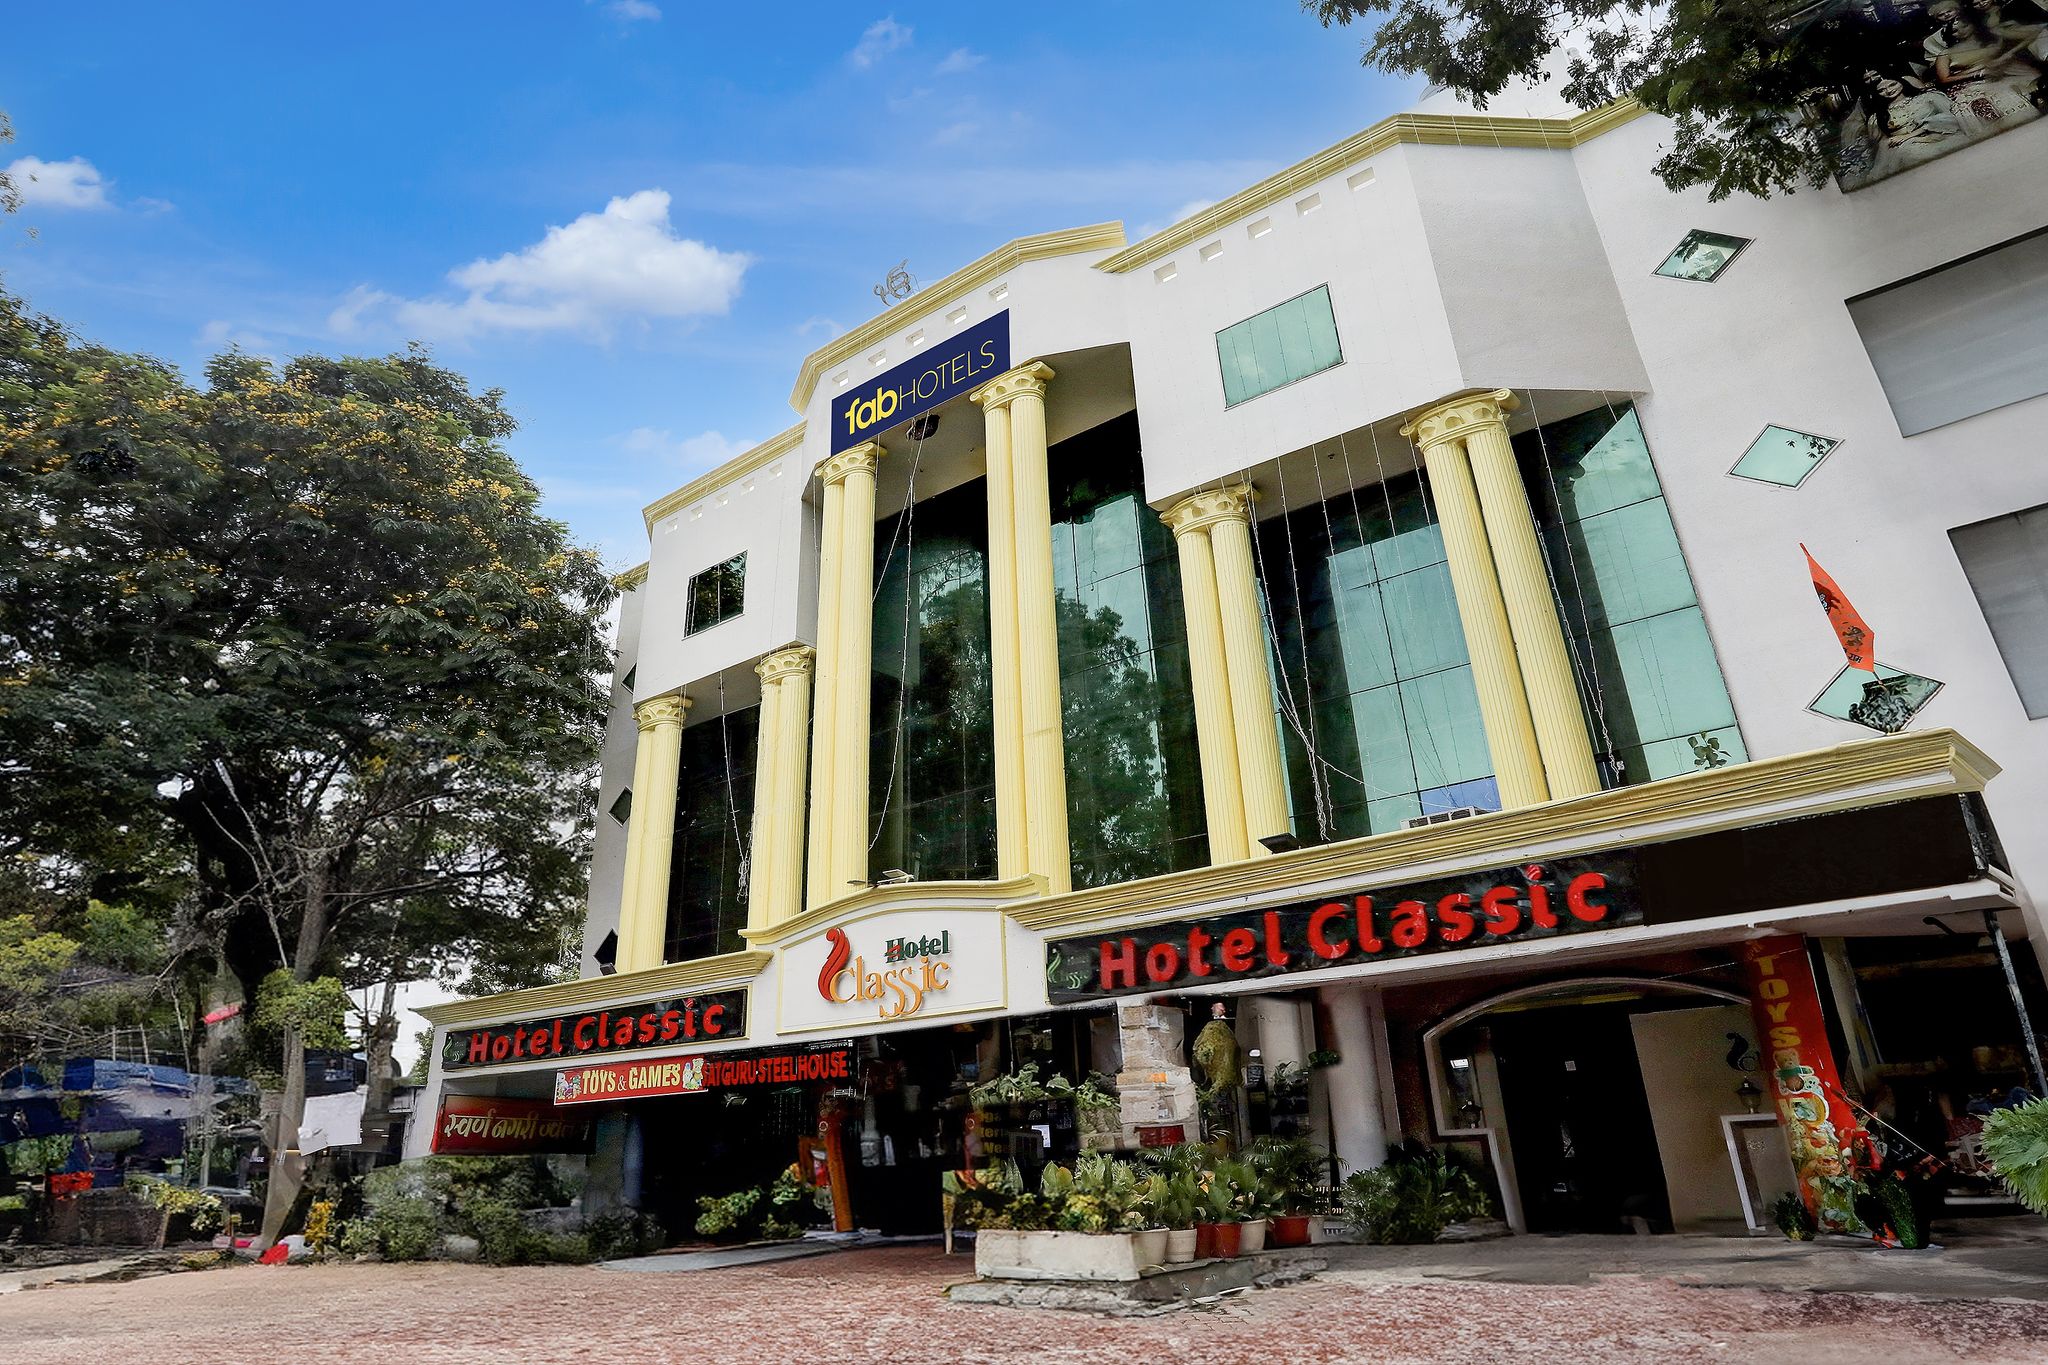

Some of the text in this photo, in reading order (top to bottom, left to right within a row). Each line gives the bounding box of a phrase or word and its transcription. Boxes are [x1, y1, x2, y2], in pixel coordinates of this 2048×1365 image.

[884, 930, 950, 963] Hotel
[1099, 911, 1289, 990] Hotel
[1307, 865, 1608, 960] Classic
[829, 956, 949, 1017] Classic
[1753, 954, 1801, 1048] TOYS
[469, 1019, 563, 1063] Hotel
[574, 998, 724, 1050] Classic
[583, 1064, 680, 1094] TOYS & GAMES
[758, 1056, 796, 1083] STEEL
[797, 1051, 848, 1080] HOUSE
